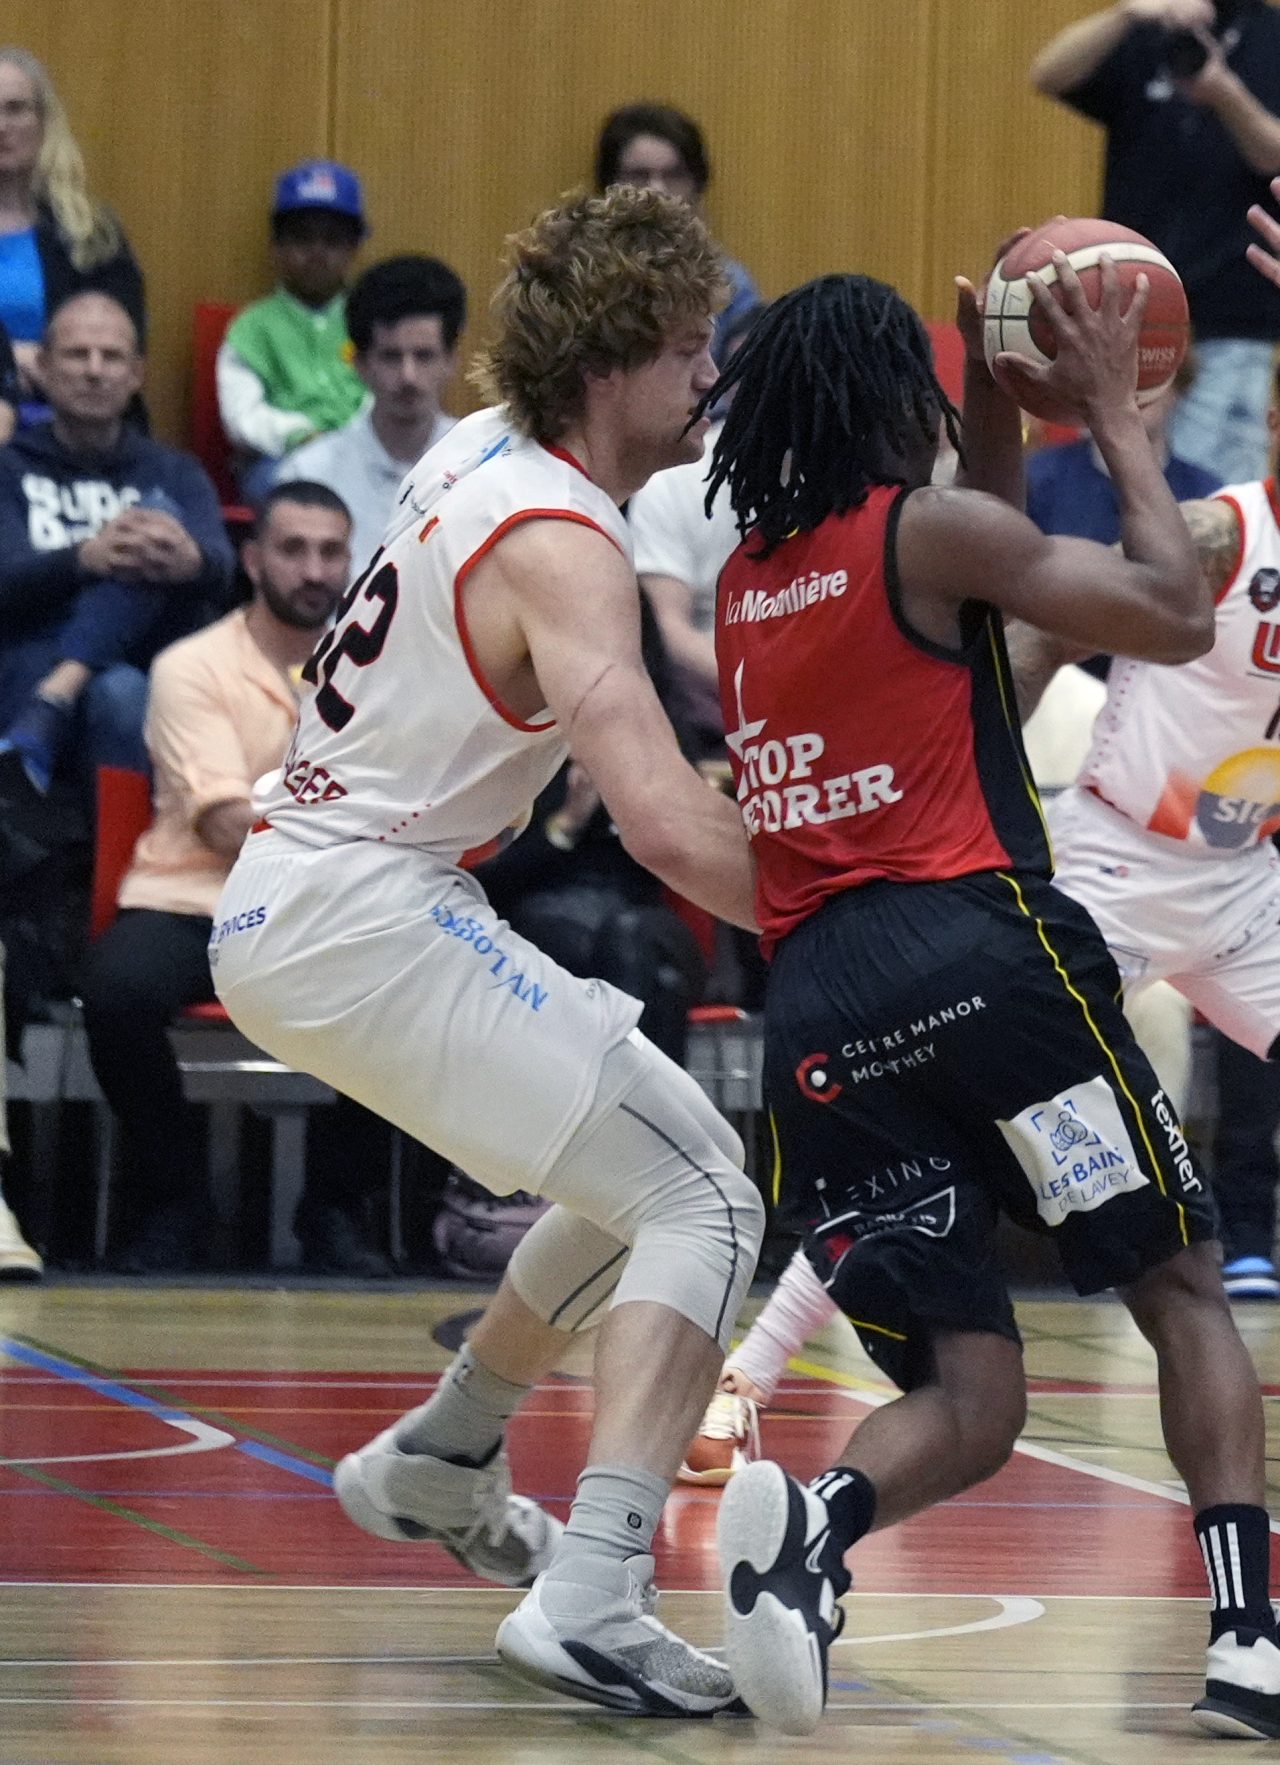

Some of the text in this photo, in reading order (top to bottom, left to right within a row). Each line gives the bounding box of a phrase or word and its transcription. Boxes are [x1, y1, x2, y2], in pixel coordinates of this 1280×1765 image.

[744, 733, 825, 788] TOP
[742, 764, 904, 838] CORER
[910, 995, 986, 1036] MANOR
[851, 1043, 937, 1084] MOTHEY
[1151, 1089, 1203, 1193] texner
[1039, 1147, 1125, 1200] LES BAIN
[1079, 1169, 1131, 1202] LAVEY
